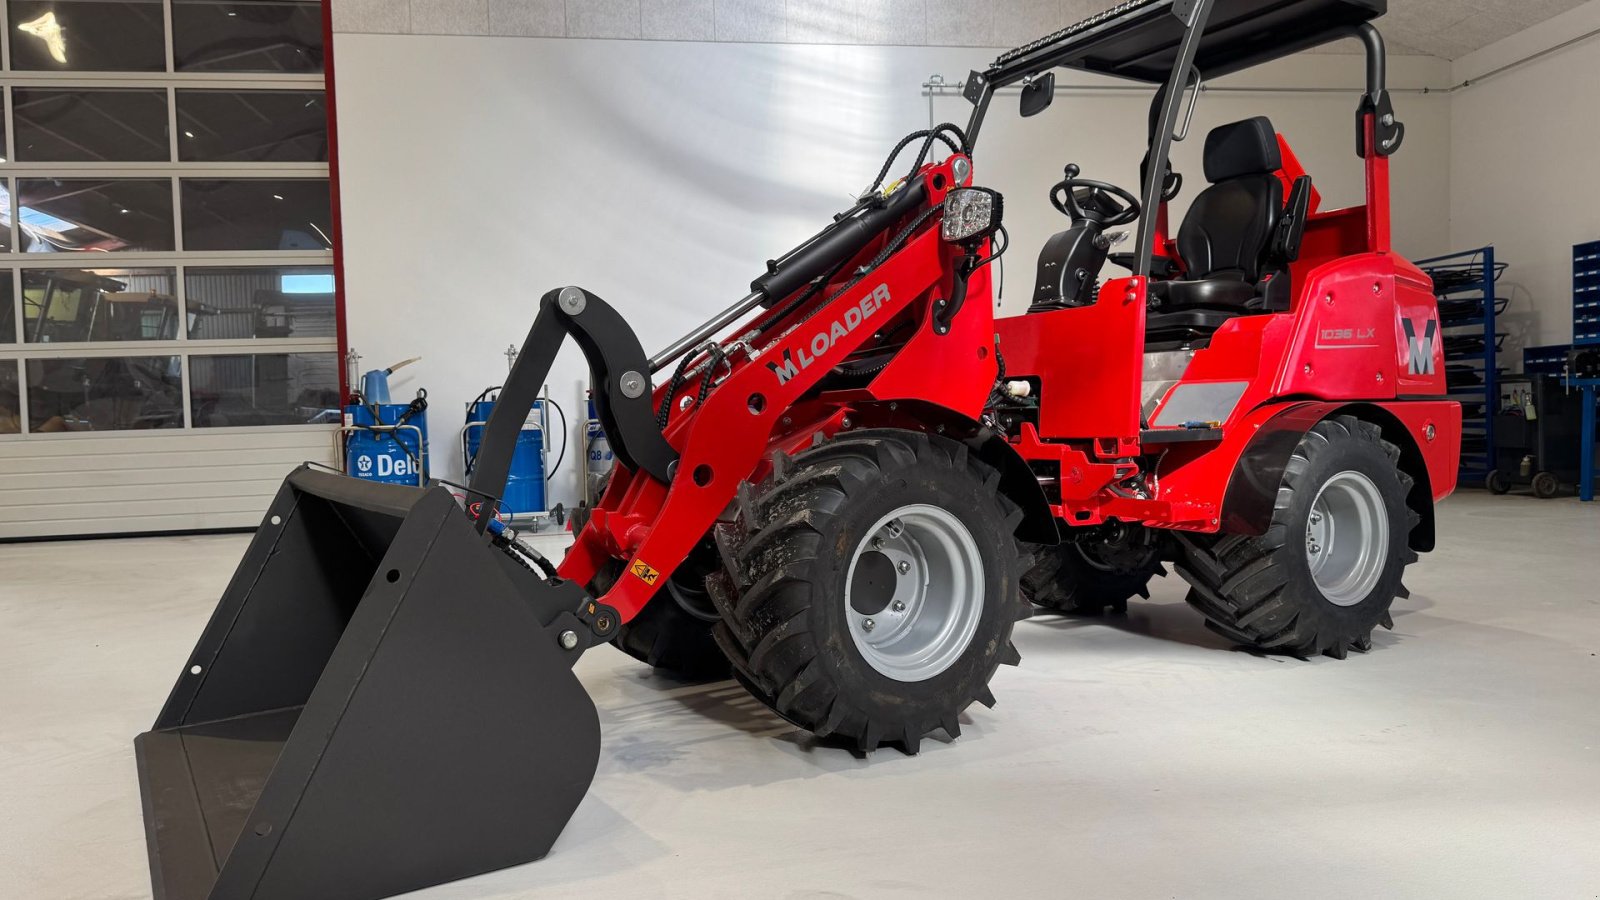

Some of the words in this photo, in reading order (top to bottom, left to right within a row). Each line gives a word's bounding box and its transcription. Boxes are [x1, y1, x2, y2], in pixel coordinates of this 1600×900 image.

[797, 283, 891, 370] LOADER
[1356, 328, 1376, 339] LX
[590, 450, 602, 461] Q8
